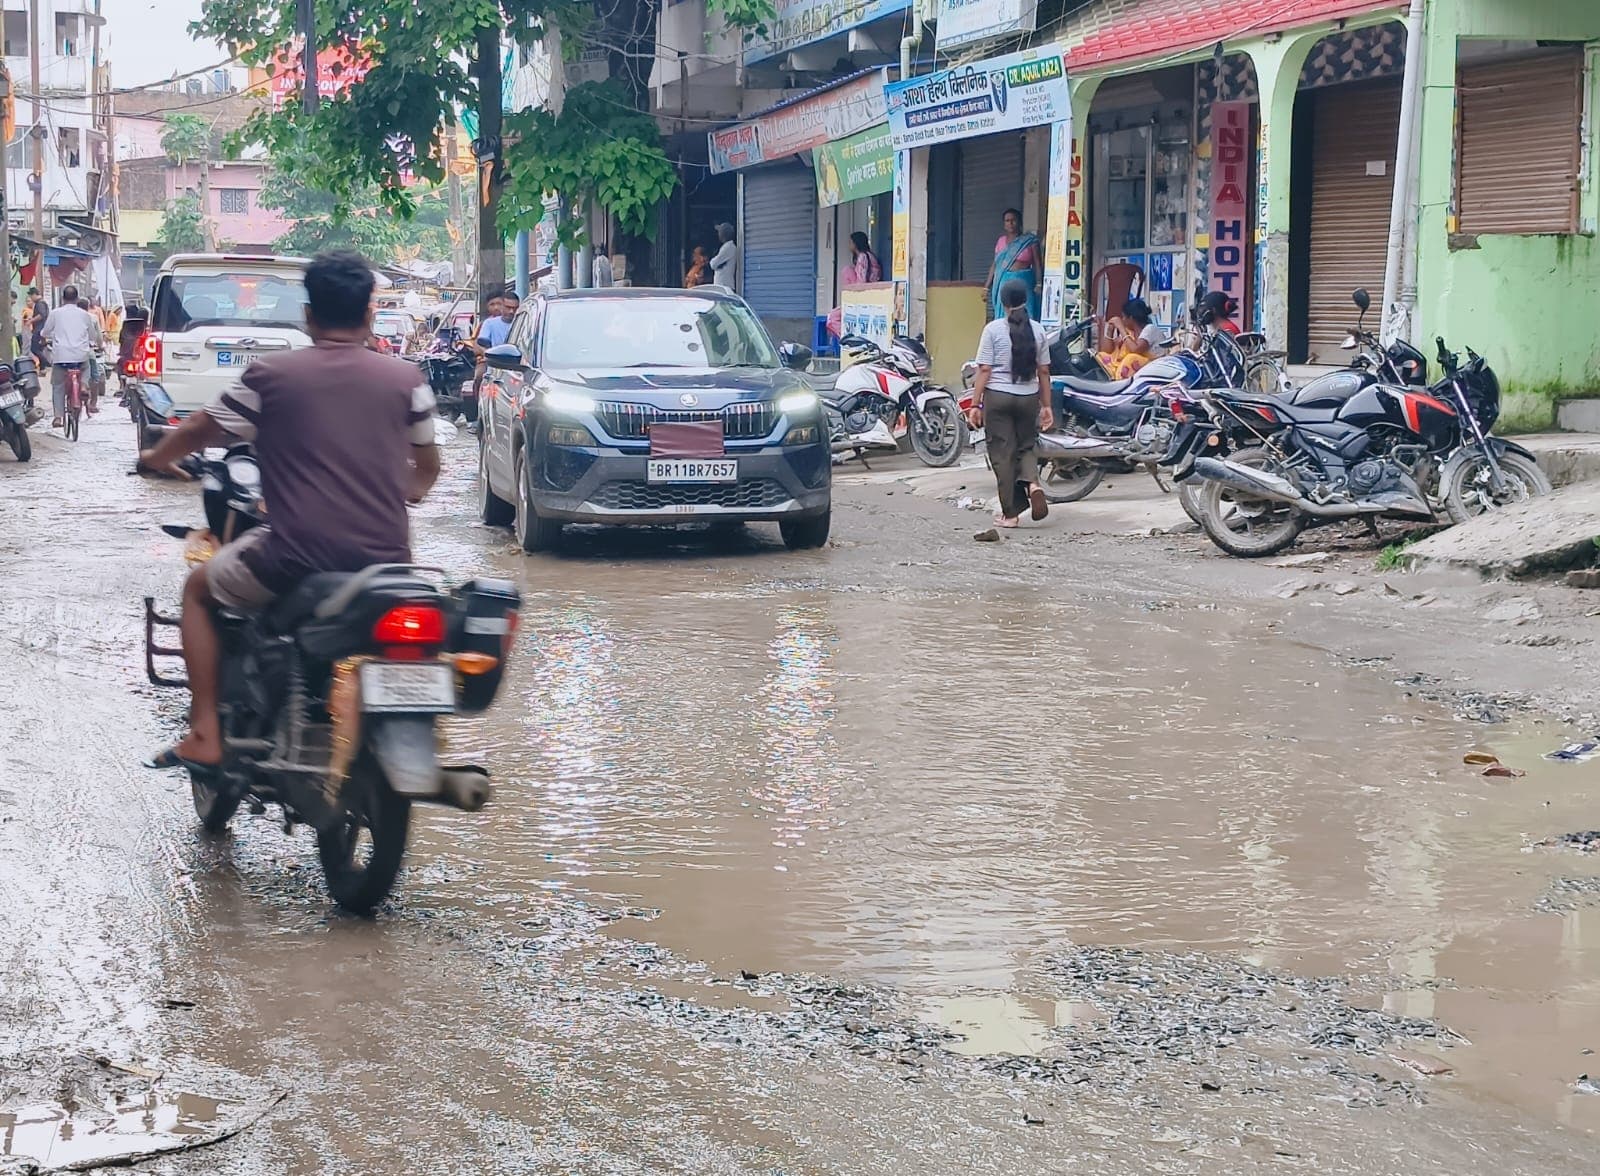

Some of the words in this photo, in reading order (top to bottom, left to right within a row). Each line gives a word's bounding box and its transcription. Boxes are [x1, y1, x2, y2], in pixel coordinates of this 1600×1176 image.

[902, 83, 929, 108] आशा
[928, 77, 948, 104] हेल्थ
[947, 66, 988, 97] क्लिनिक
[1021, 63, 1041, 83] AQUIL
[1040, 58, 1061, 76] RAZA
[1216, 110, 1244, 204] INDIA
[1067, 138, 1081, 227] INDIA
[657, 463, 736, 477] BR11BR7657
